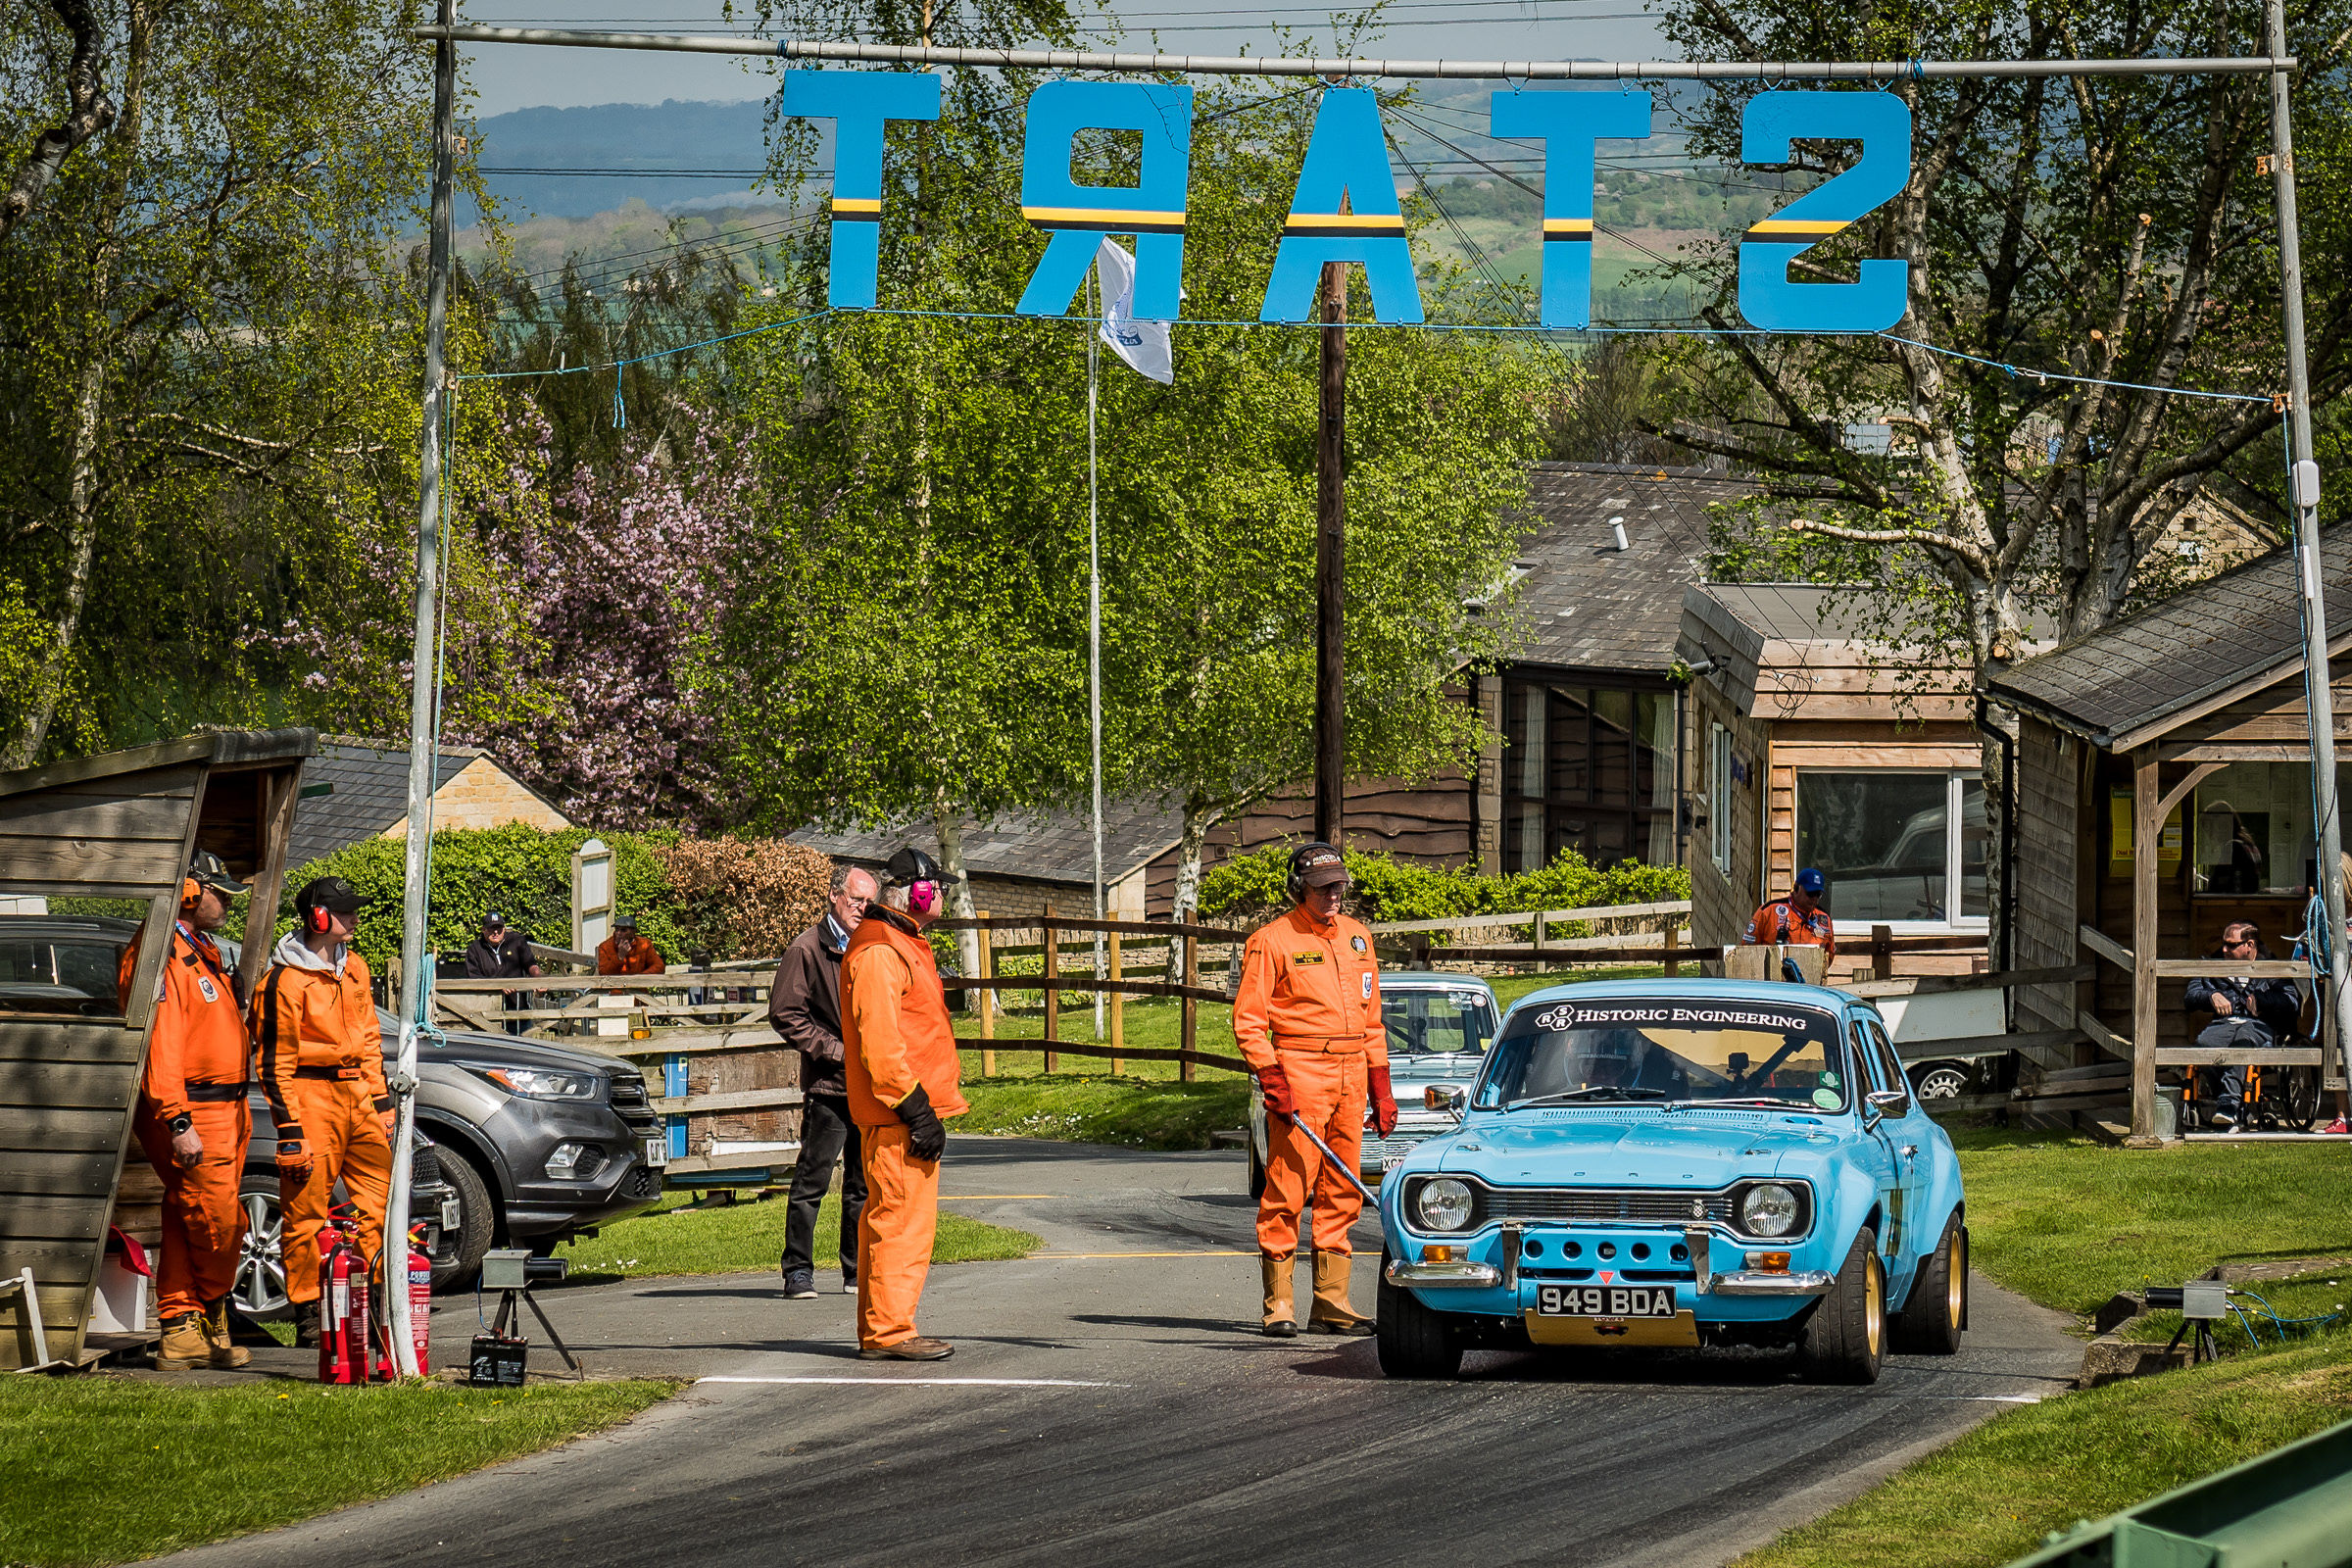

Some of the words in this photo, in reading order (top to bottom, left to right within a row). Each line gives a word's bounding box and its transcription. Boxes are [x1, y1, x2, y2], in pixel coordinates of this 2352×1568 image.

[1575, 1009, 1668, 1022] HISTORIC
[1671, 1008, 1806, 1030] ENGINEERING
[1542, 1288, 1602, 1313] 949
[1610, 1290, 1672, 1315] BDA
